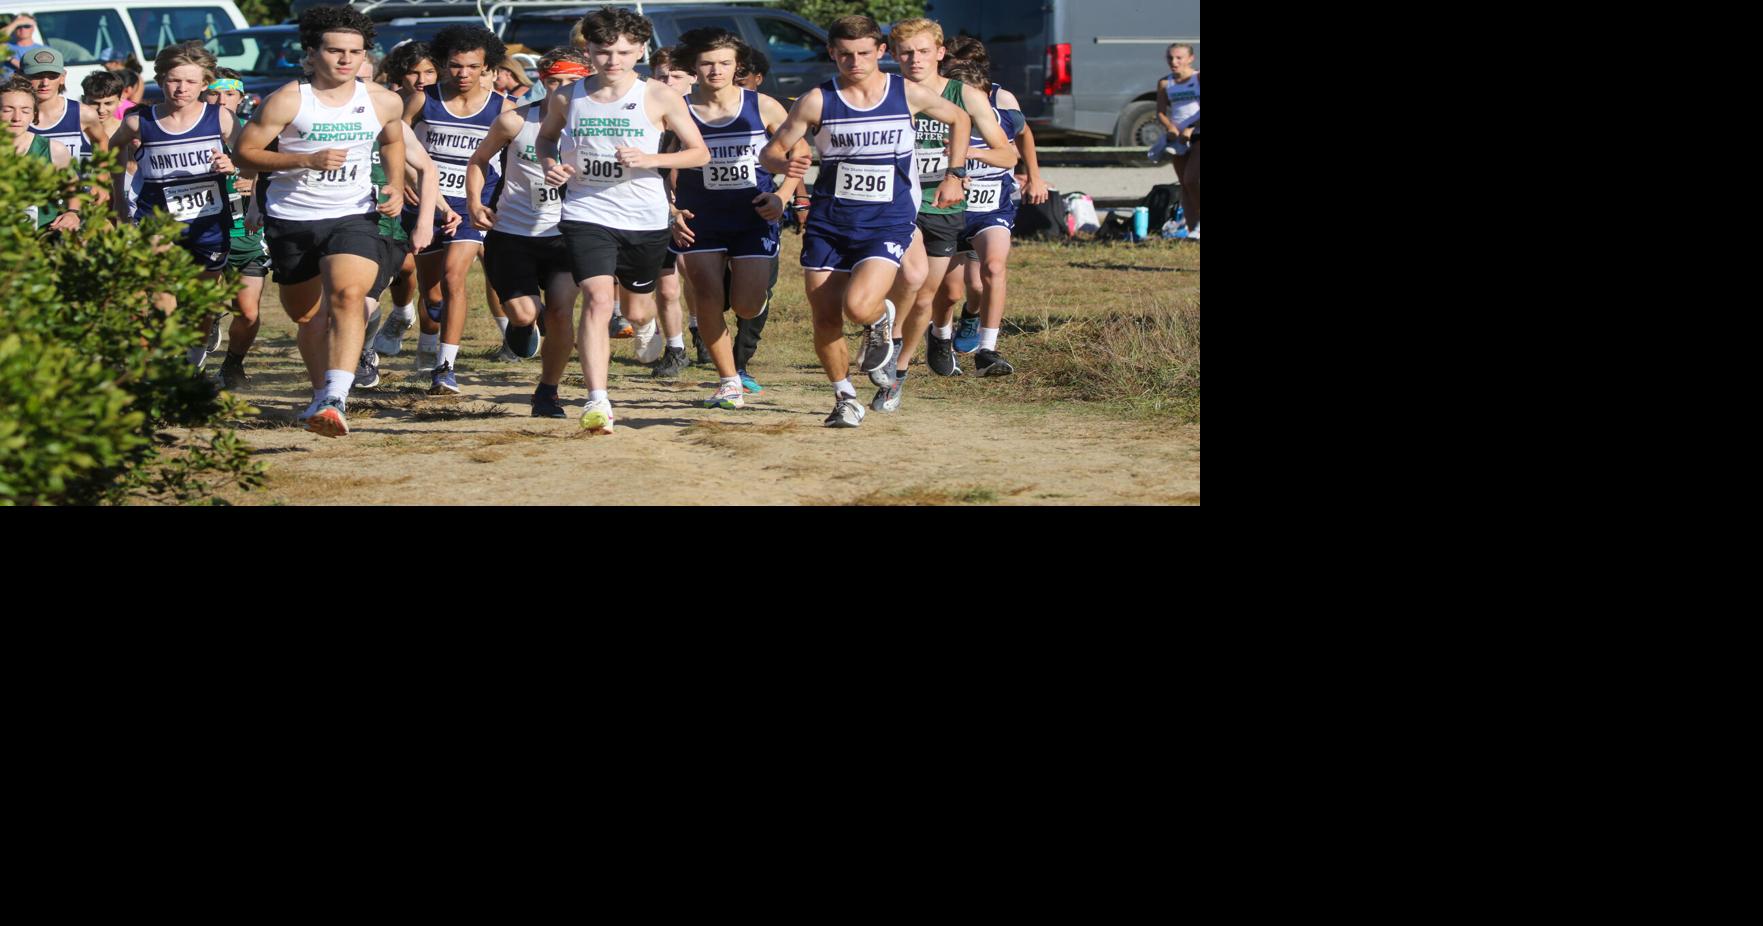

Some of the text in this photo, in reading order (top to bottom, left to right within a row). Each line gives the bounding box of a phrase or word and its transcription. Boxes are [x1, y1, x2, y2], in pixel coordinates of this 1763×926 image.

[312, 122, 362, 132] DENNIS
[579, 118, 630, 127] DENNIS
[916, 119, 949, 134] RGIS
[297, 130, 374, 142] YARMOUTH
[426, 130, 483, 150] NANTUCKE
[831, 129, 903, 148] NANTUCKET
[916, 132, 943, 141] RTER
[149, 149, 212, 170] NANTUCKE
[583, 158, 623, 178] 3005
[917, 157, 941, 174] 77
[316, 164, 358, 182] 3014
[438, 171, 466, 189] 299
[709, 165, 749, 182] 3298
[843, 173, 886, 192] 3296
[173, 190, 215, 212] 3304
[538, 187, 558, 203] 30
